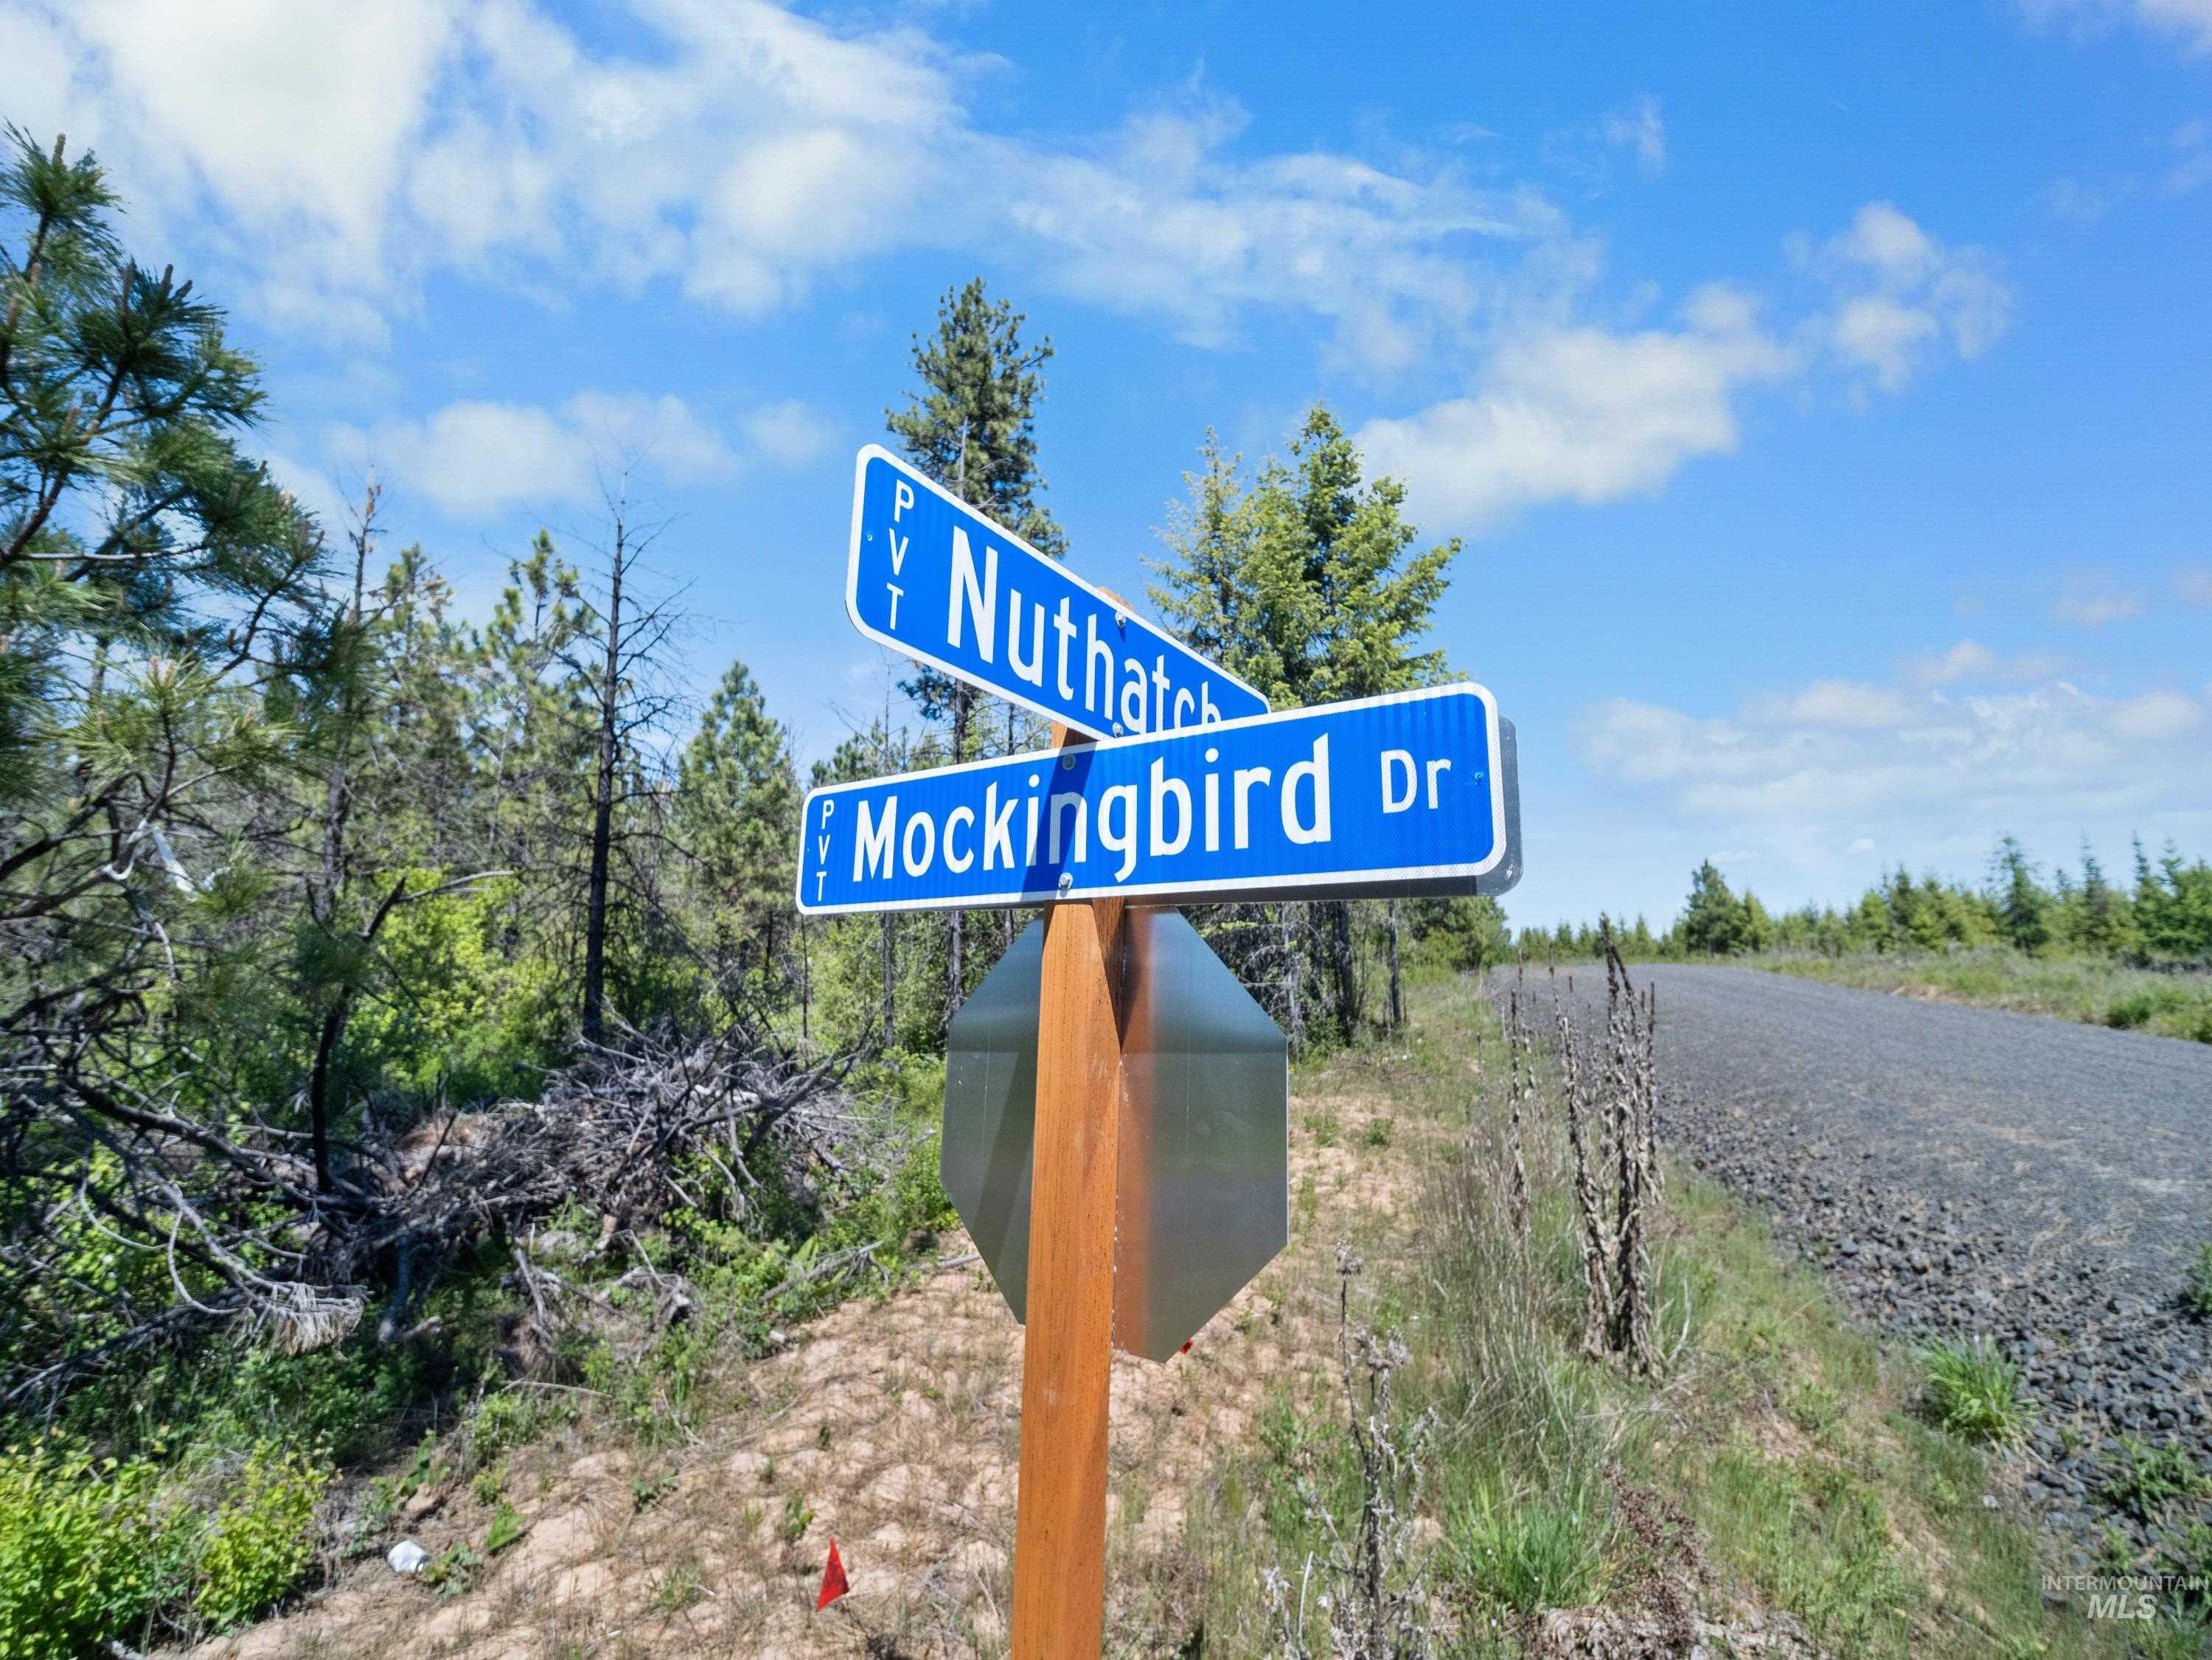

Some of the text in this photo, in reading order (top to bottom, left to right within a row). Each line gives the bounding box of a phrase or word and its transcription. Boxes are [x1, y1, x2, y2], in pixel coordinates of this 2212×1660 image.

[886, 479, 914, 631] PVT
[816, 799, 834, 902] PVT
[852, 732, 1452, 883] Mockingbird Dr
